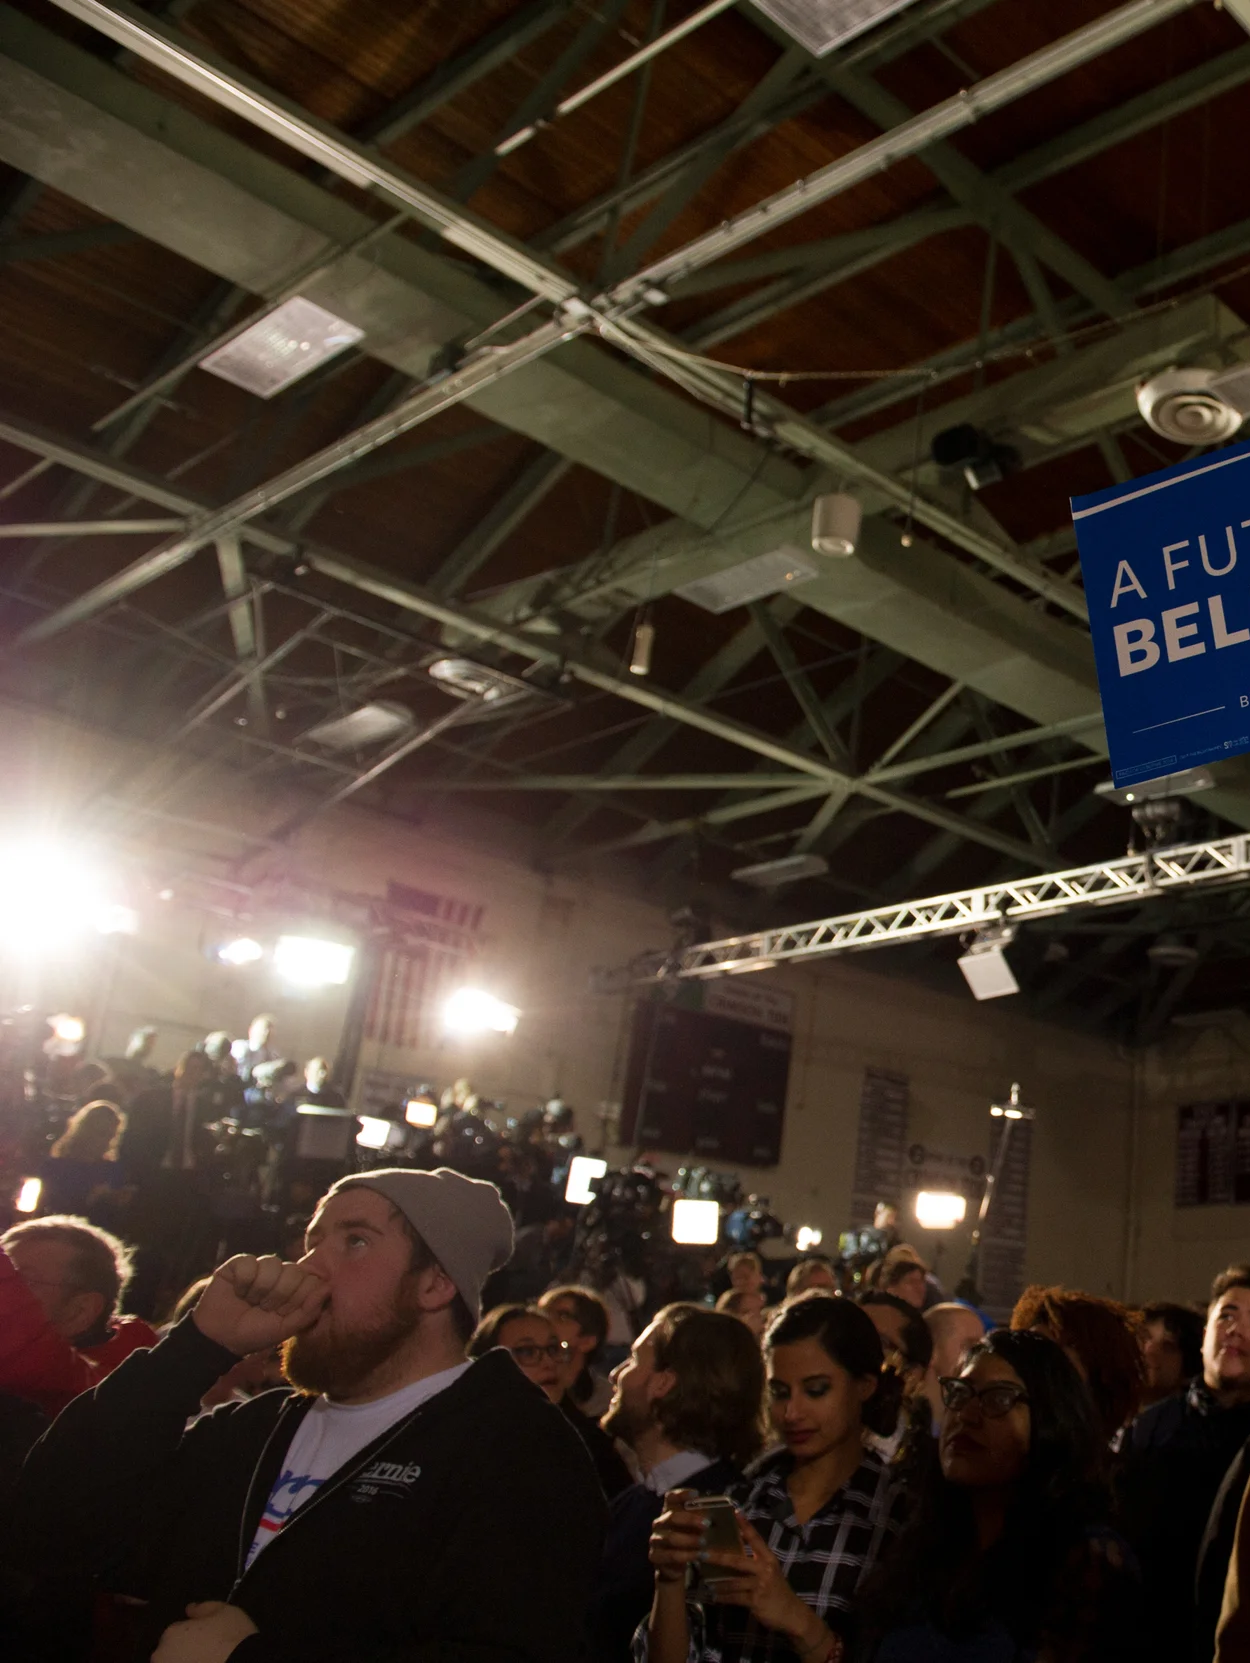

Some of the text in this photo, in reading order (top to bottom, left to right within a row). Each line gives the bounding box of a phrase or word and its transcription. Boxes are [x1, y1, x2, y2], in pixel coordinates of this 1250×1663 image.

[1110, 559, 1148, 608] A
[365, 1460, 422, 1483] ernie
[357, 1484, 379, 1496] 2016
